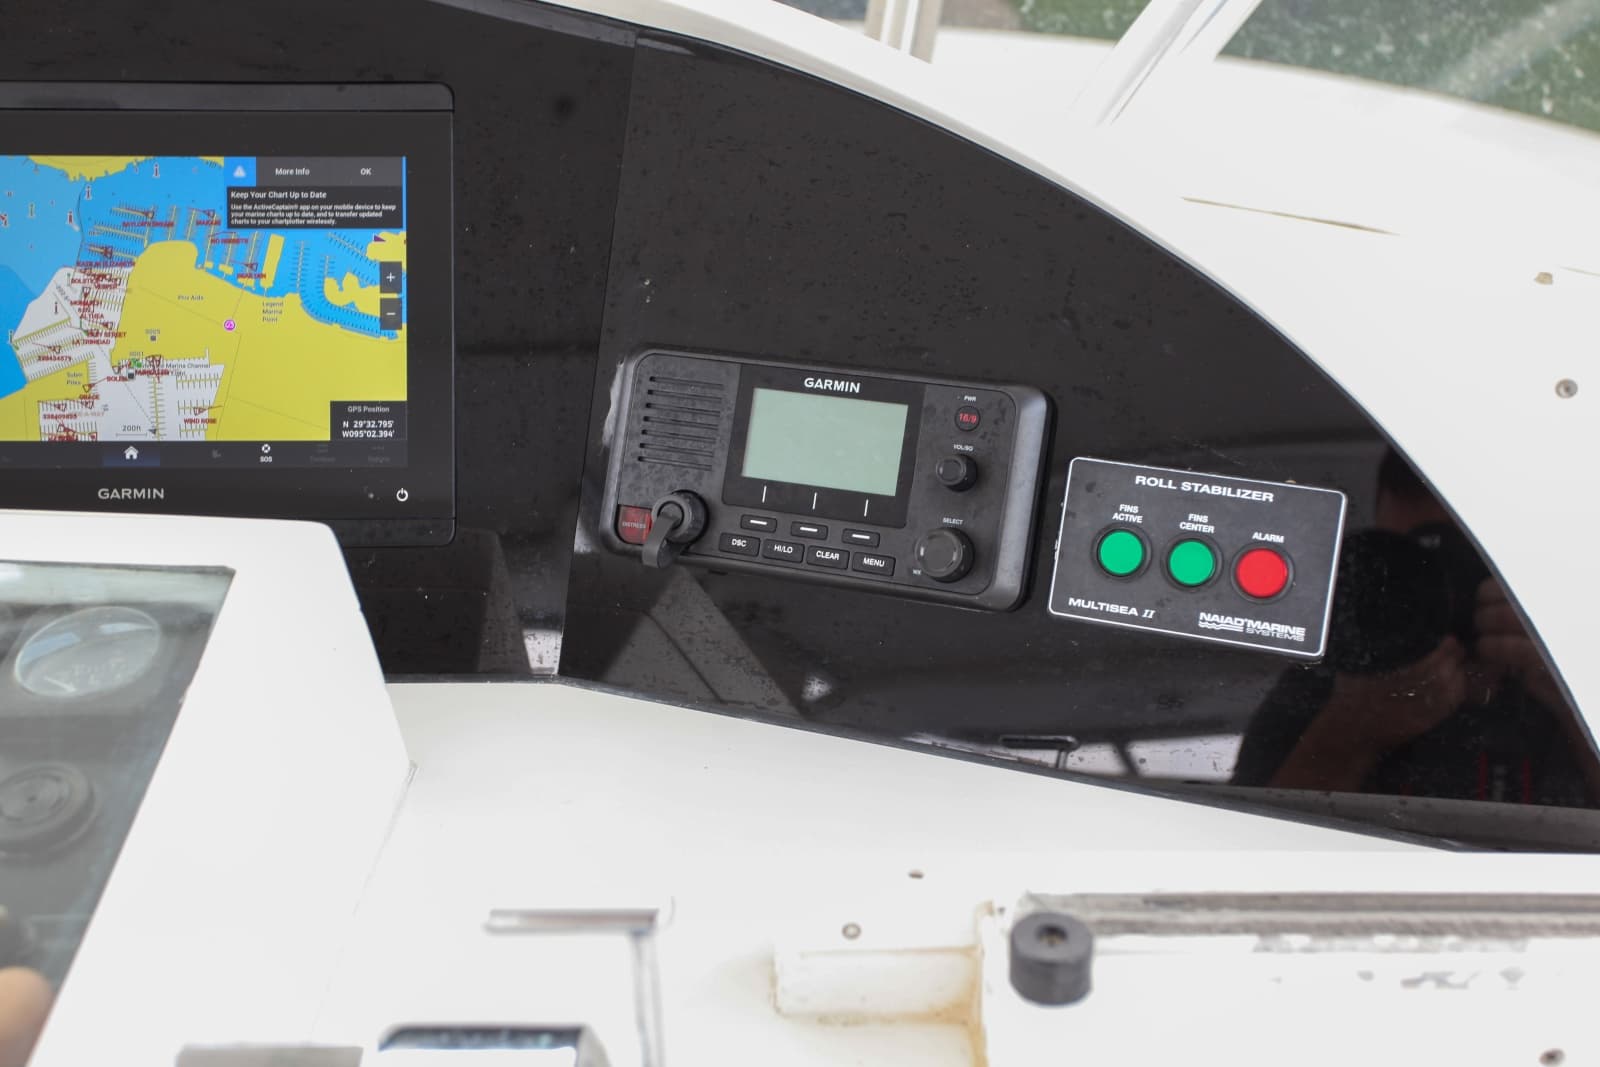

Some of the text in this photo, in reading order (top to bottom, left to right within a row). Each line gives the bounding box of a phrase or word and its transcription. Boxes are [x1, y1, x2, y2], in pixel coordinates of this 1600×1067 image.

[275, 168, 310, 176] More Info
[360, 168, 372, 176] OK
[231, 191, 248, 199] Keep
[289, 191, 300, 199] Up
[299, 203, 310, 211] app
[320, 203, 332, 211] your
[382, 203, 396, 211] keep
[257, 218, 270, 226] your
[272, 218, 305, 226] chartplotter
[306, 218, 336, 226] wirelessly.
[804, 378, 861, 394] GARMIN
[959, 412, 977, 424] 16/9
[98, 488, 165, 500] GARMIN
[1135, 475, 1274, 502] ROLL STABILIZER
[1119, 504, 1139, 514] FINS
[942, 517, 964, 525] SELECT
[1112, 513, 1143, 524] ACTIVE
[1188, 513, 1208, 523] FINS
[1180, 522, 1215, 534] CENTER
[731, 538, 747, 548] DSC
[1252, 532, 1284, 544] ALARM
[774, 544, 793, 554] HI/LO
[816, 550, 840, 561] CLEAR
[863, 557, 885, 568] MENU
[1068, 597, 1155, 619] MULTISEA II
[1246, 628, 1305, 642] SYSTEMS
